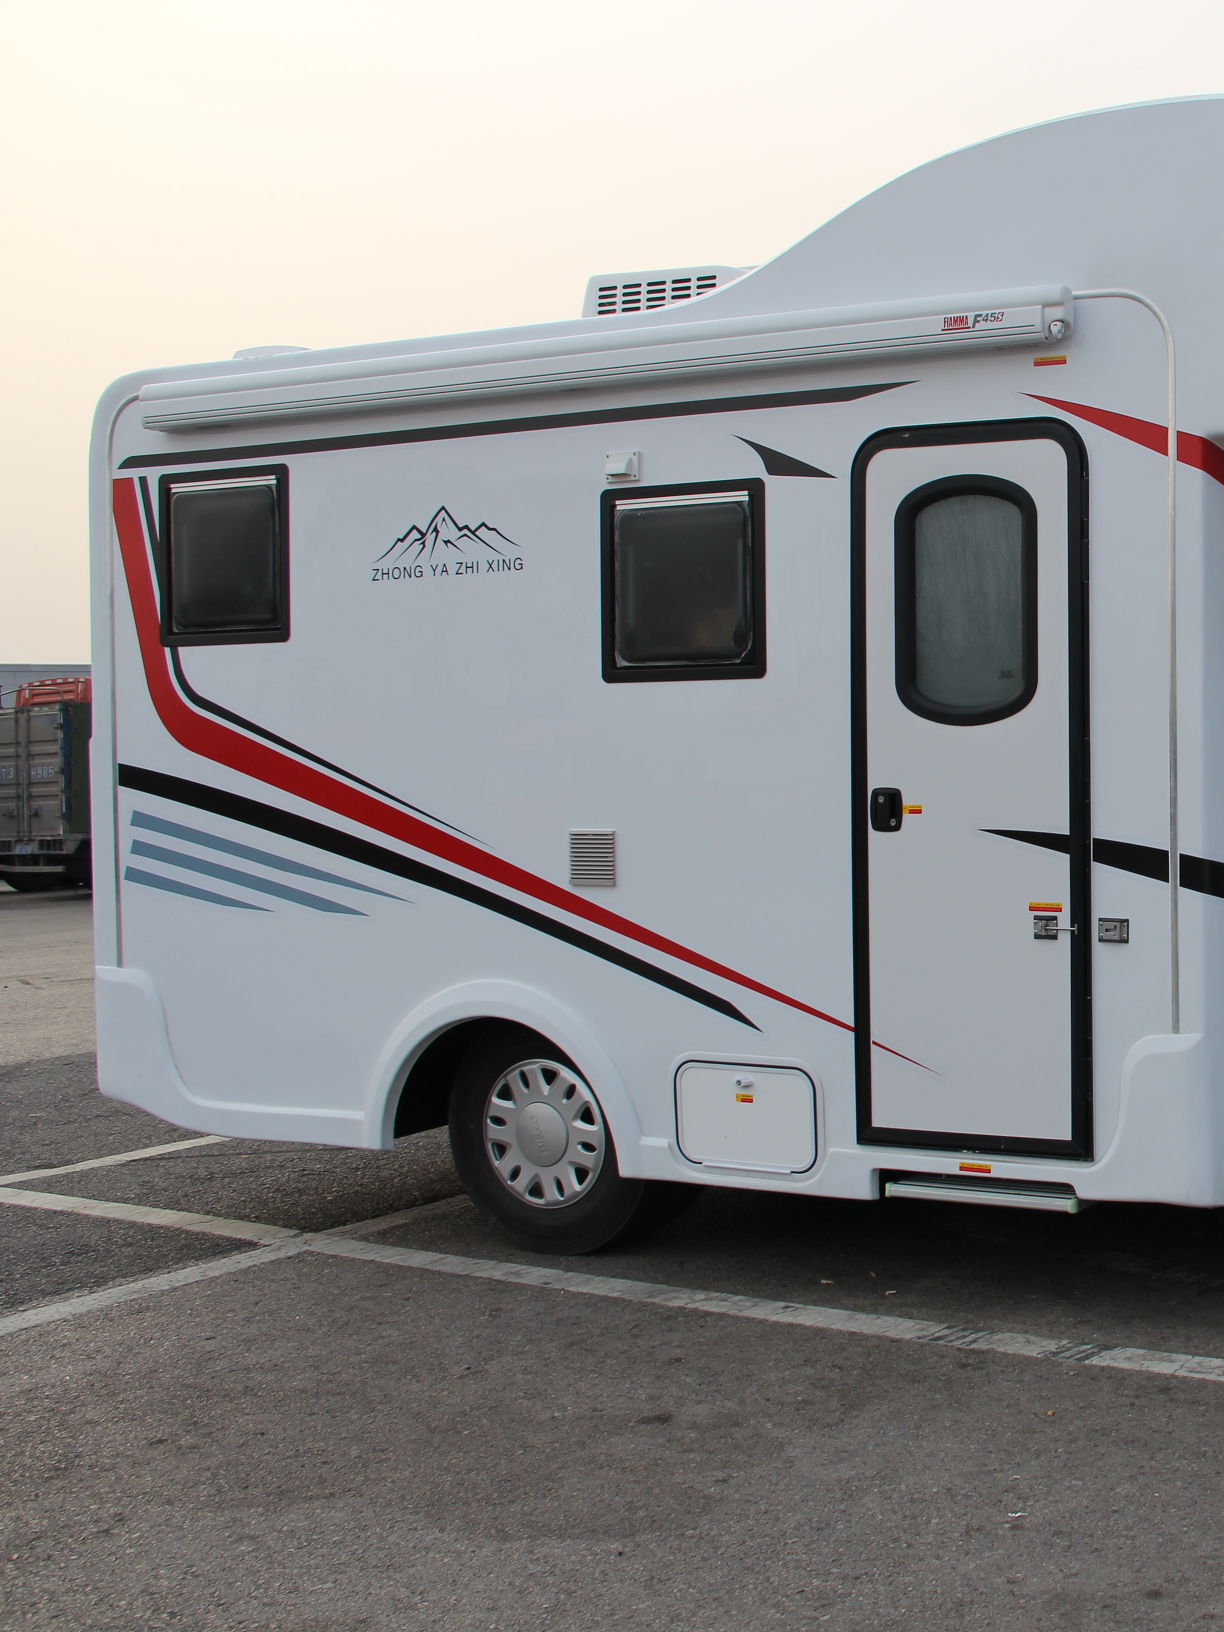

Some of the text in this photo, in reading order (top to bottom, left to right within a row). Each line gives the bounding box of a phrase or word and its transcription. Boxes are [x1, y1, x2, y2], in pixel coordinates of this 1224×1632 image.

[943, 315, 969, 328] FIAMMA
[372, 557, 524, 582] ZHONG YA ZHI XING
